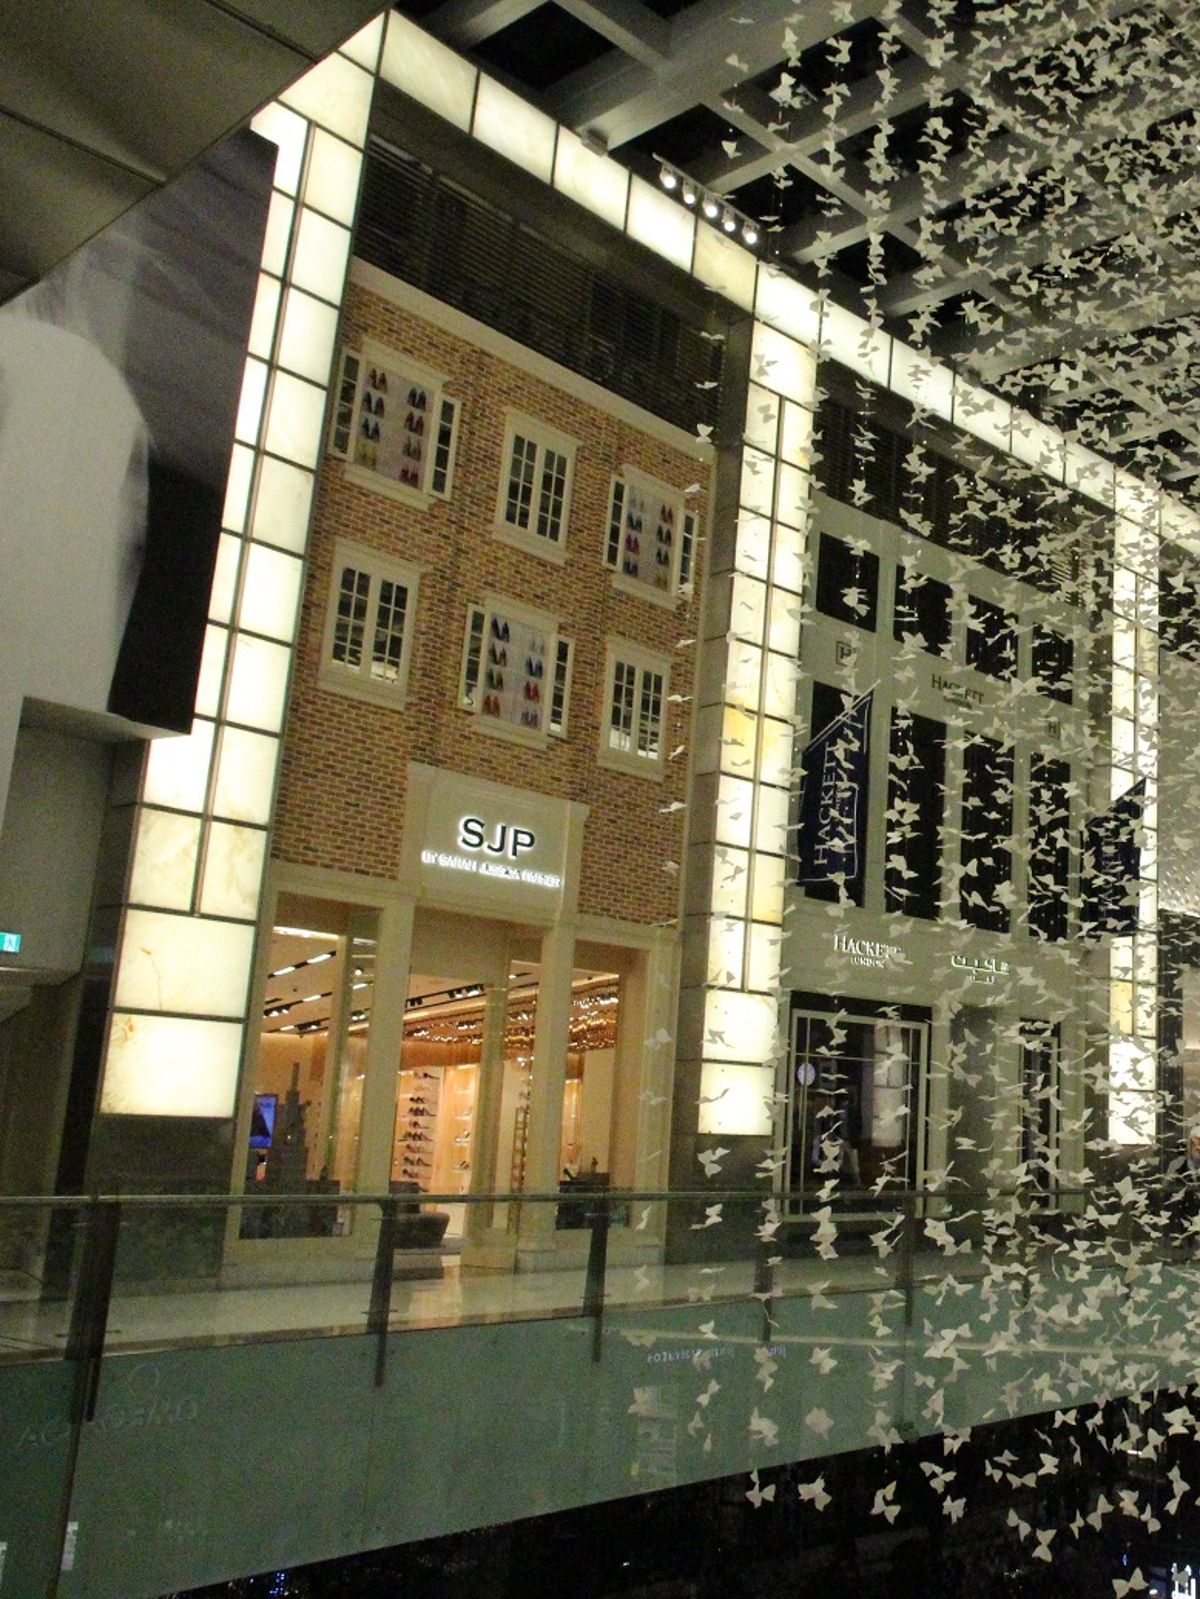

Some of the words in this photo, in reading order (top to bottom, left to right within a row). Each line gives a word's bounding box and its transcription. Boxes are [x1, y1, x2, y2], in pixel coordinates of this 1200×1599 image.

[931, 673, 985, 705] HACETT
[813, 740, 837, 867] HACKETT
[458, 815, 537, 859] SJP
